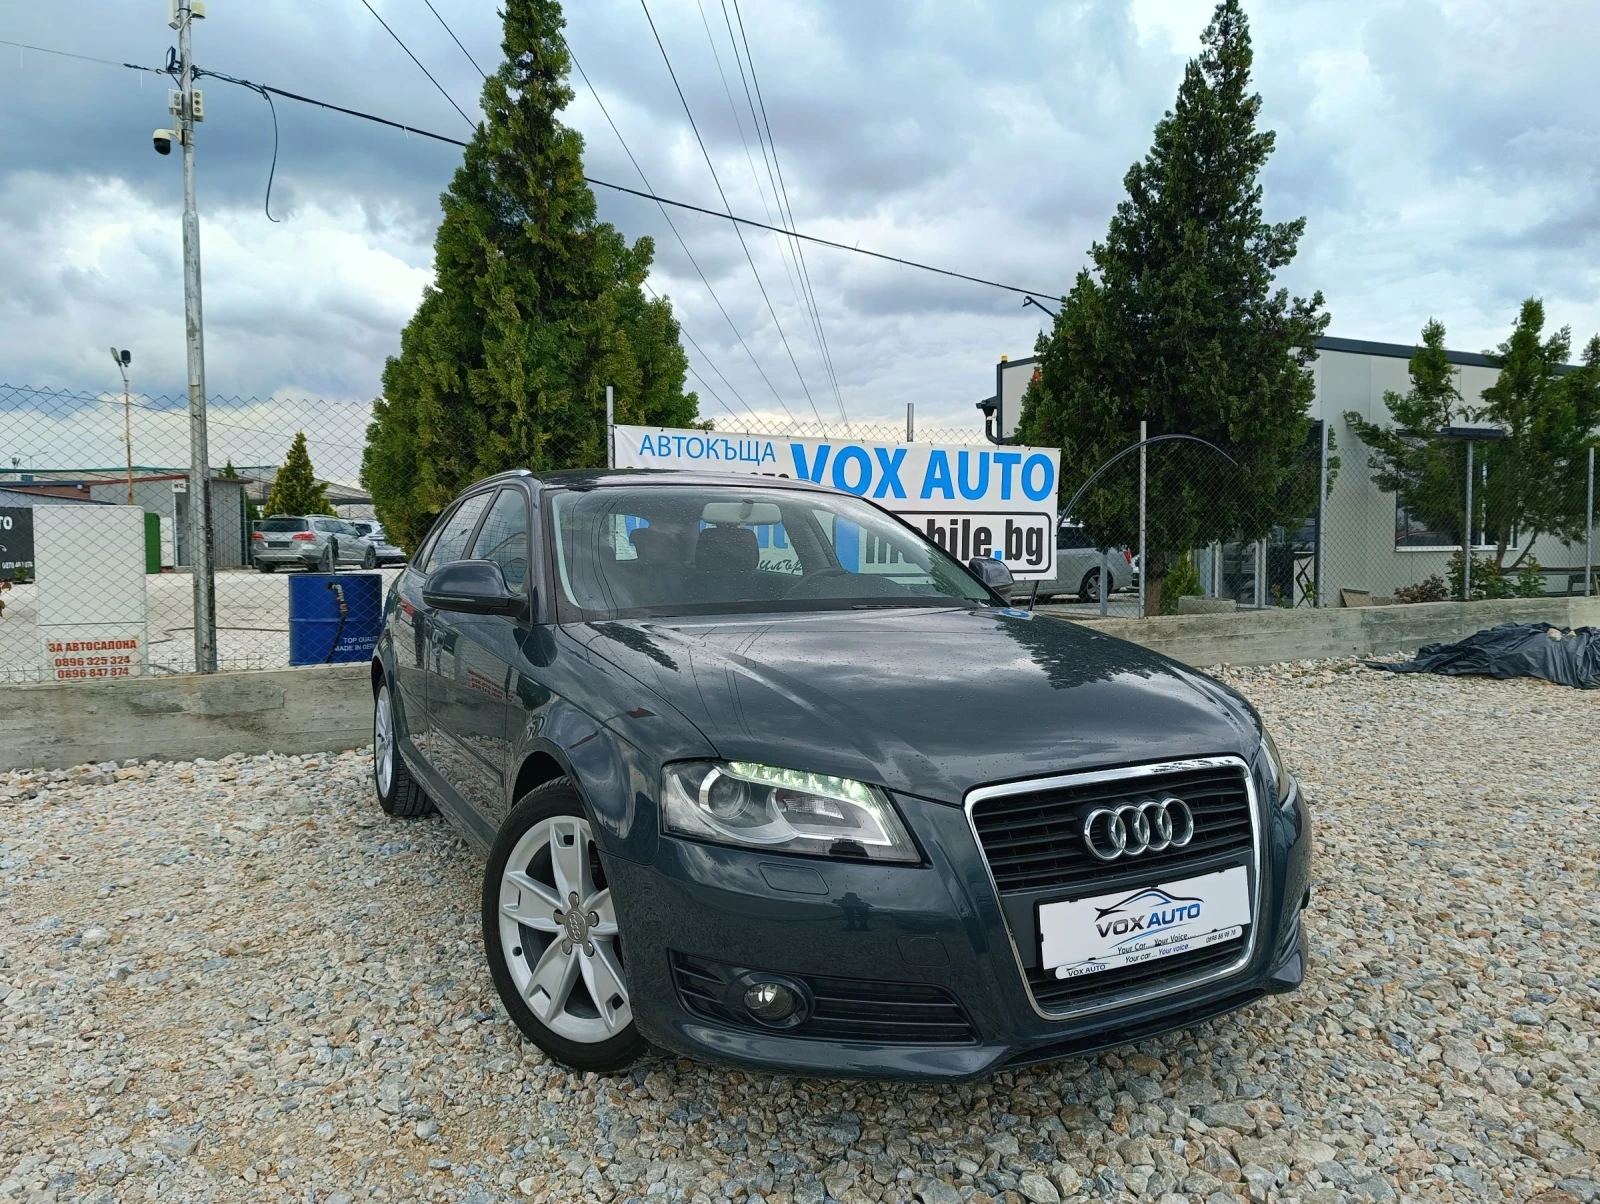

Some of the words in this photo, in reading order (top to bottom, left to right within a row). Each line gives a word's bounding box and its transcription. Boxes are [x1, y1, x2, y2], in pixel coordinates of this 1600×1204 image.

[639, 434, 776, 466] АВТОКЪЩА
[790, 444, 907, 499] VOX
[920, 449, 1055, 502] AUTO
[48, 642, 63, 653] ЗА
[65, 640, 137, 652] АВТОСАЛОНА
[55, 658, 85, 667] 0896
[86, 656, 108, 666] 325
[110, 655, 130, 665] 324
[57, 669, 87, 679] 0896
[89, 668, 108, 677] 847
[111, 667, 129, 676] 874
[1096, 915, 1146, 938] VOX
[1146, 903, 1200, 929] AUTO
[1117, 946, 1133, 955] Your
[1154, 938, 1169, 946] Your
[1125, 955, 1139, 964] Your
[1158, 948, 1172, 956] Your
[1067, 969, 1084, 977] VOX
[1084, 964, 1106, 973] AUTO
